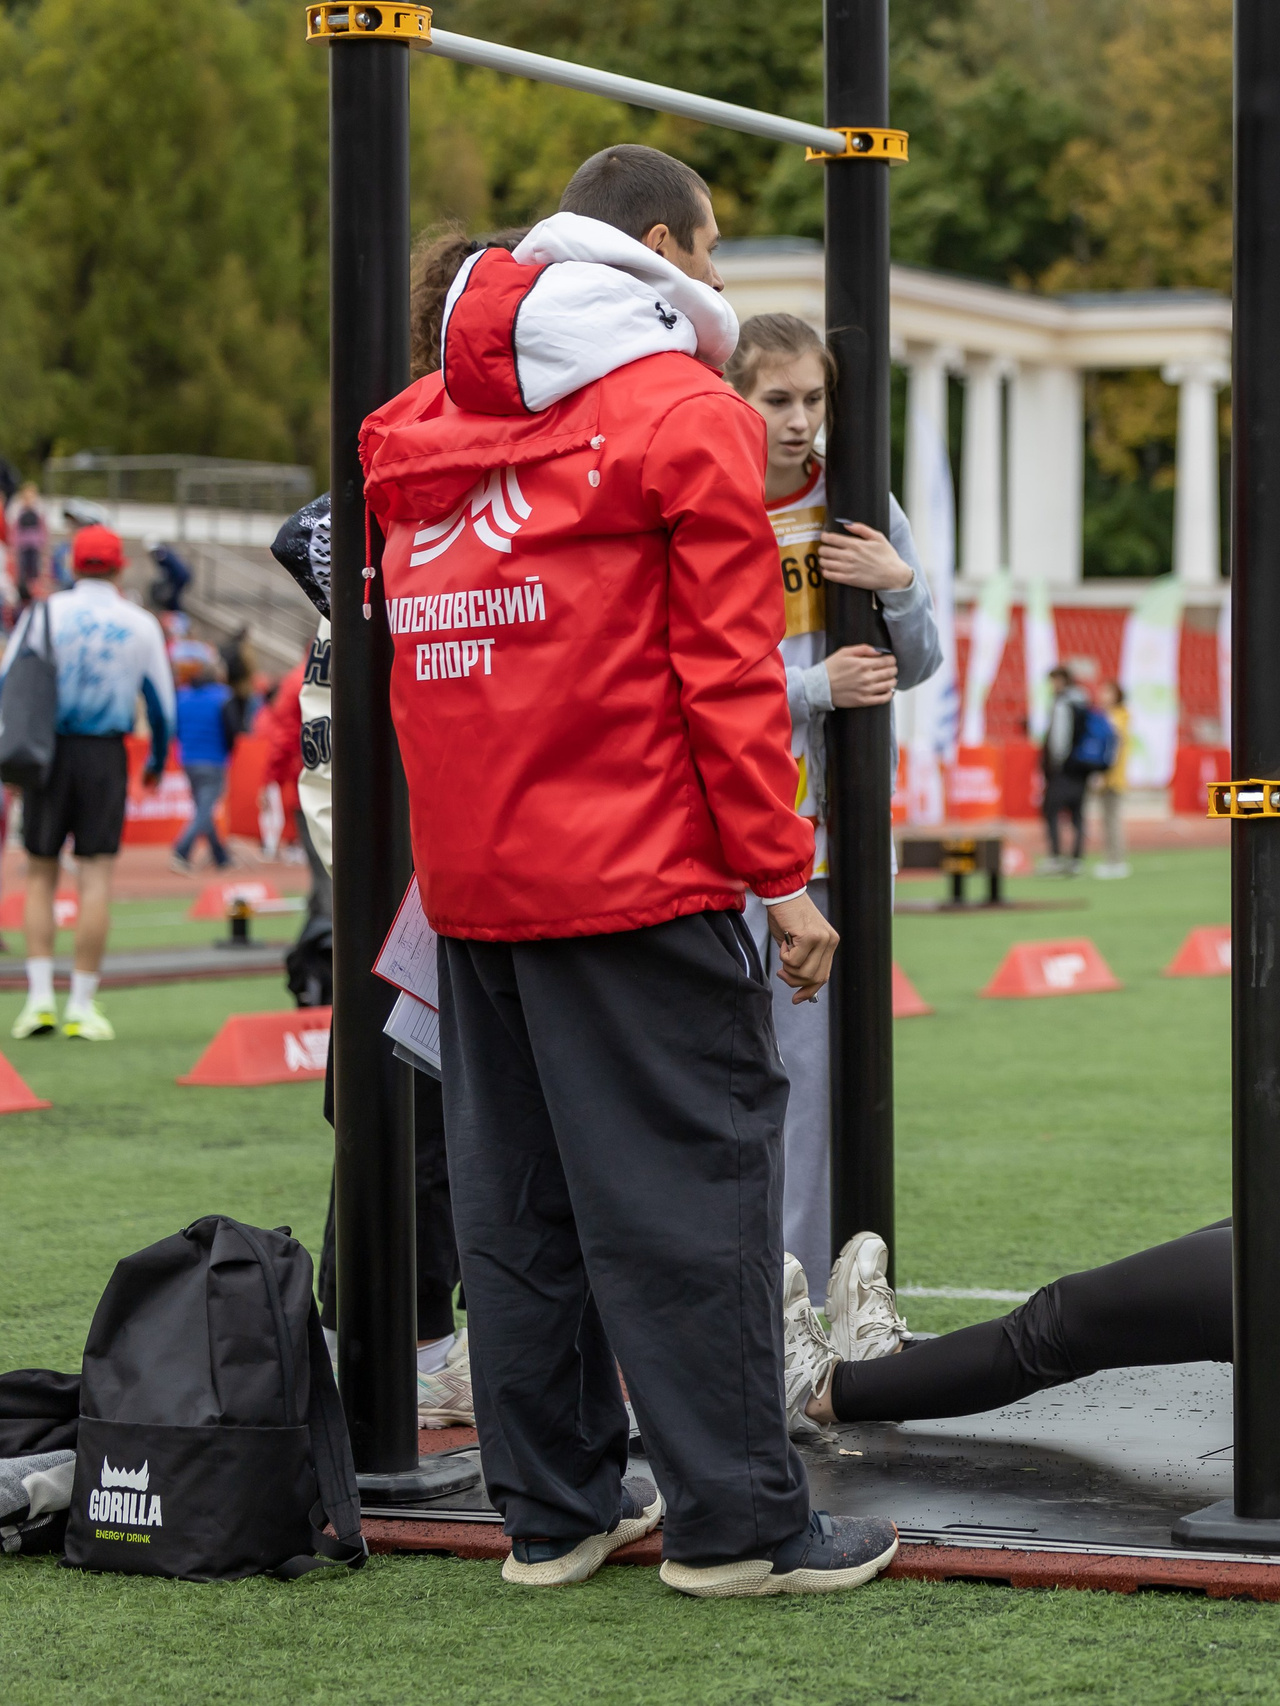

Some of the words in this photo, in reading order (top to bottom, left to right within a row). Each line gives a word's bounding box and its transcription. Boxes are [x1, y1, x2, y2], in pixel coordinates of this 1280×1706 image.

[416, 638, 496, 681] СПОРТ
[88, 1488, 163, 1527] GORILLA
[95, 1528, 125, 1541] ENERGY
[126, 1533, 151, 1544] DRINK
